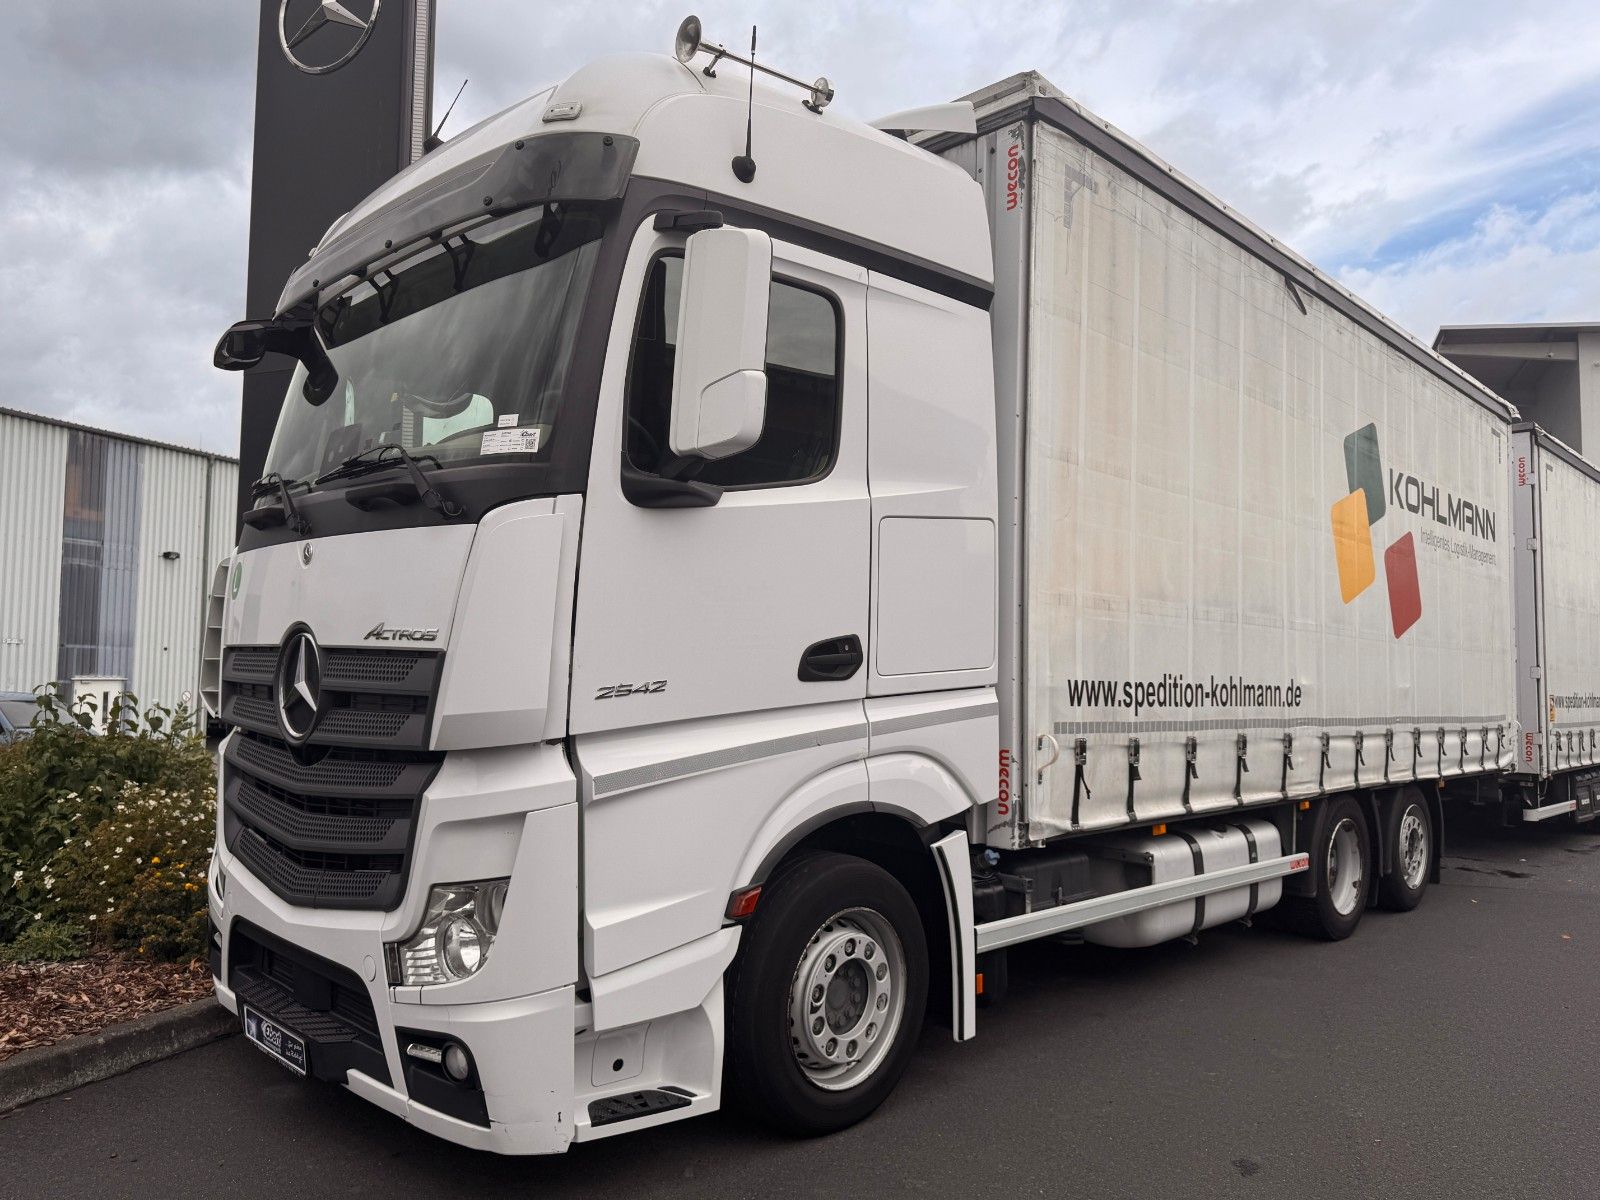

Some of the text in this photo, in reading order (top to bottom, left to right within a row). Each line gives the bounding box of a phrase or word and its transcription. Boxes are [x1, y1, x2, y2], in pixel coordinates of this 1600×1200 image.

[1007, 144, 1019, 211] wecon
[1518, 456, 1526, 487] wecon
[1389, 467, 1496, 543] KOHLMANN
[594, 679, 668, 701] 2542
[1067, 673, 1302, 717] www.spedition-kohlmann.de
[1525, 732, 1533, 762] wecon
[998, 749, 1010, 815] wecon
